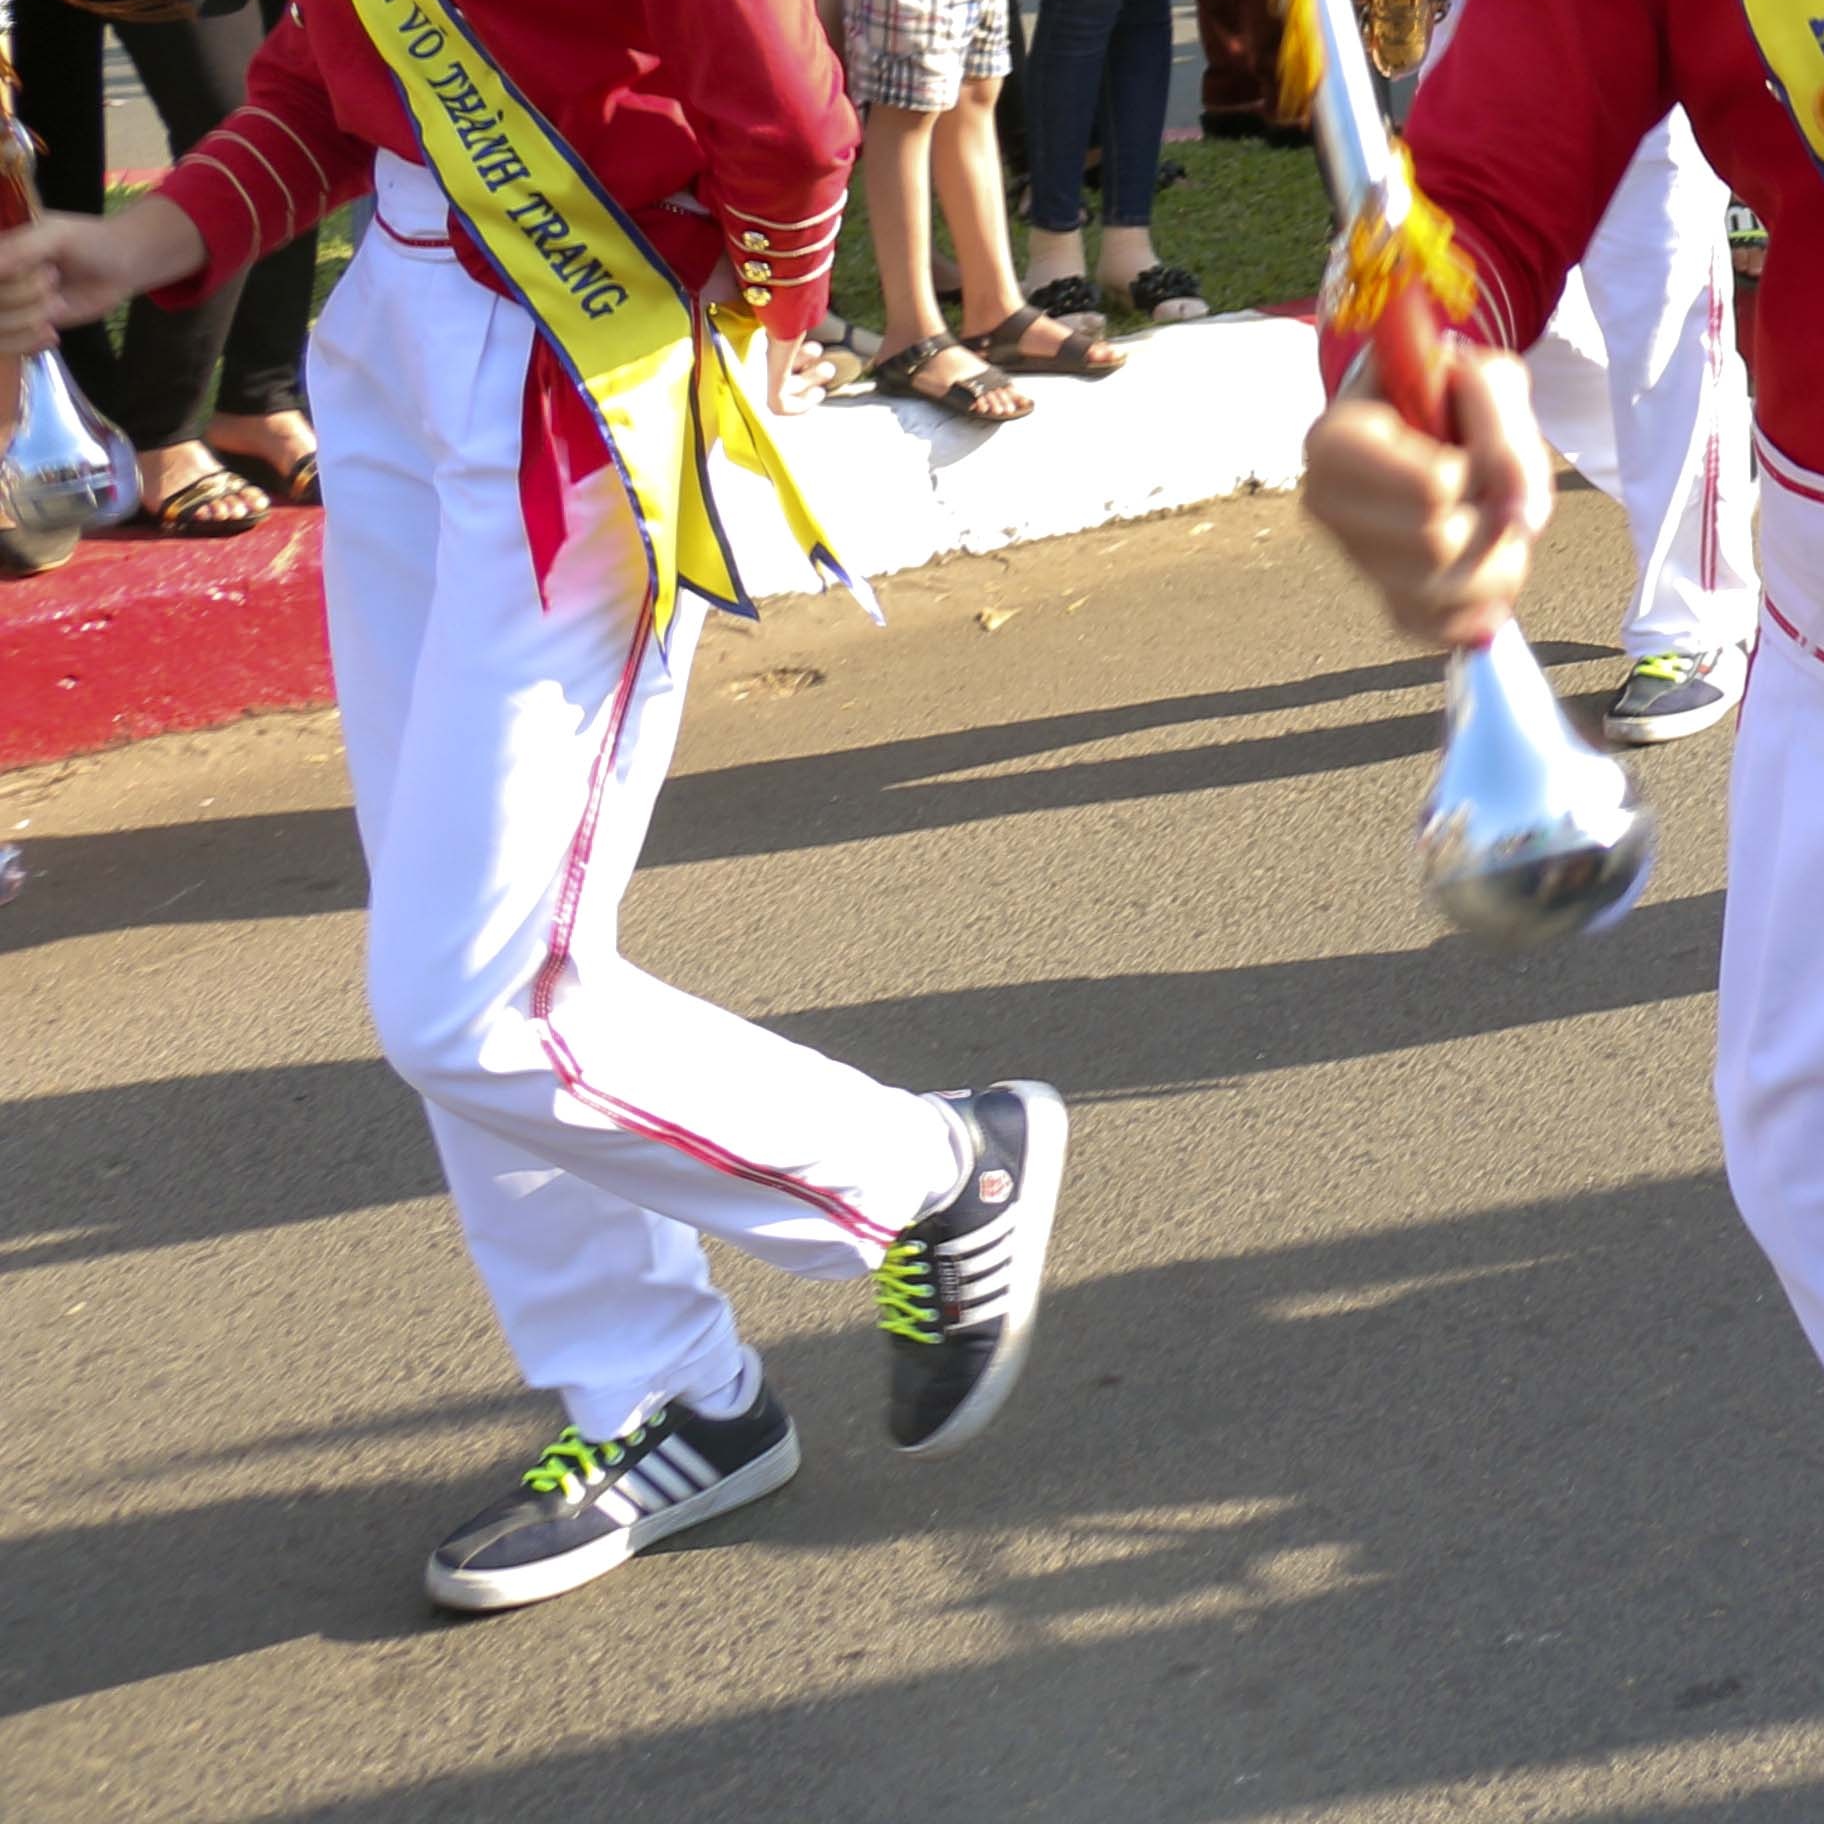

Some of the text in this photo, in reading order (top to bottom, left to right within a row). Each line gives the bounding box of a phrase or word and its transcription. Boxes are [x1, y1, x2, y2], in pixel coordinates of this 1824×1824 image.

[398, 0, 449, 60] VÕ
[426, 60, 532, 193] THÀNH
[506, 190, 630, 319] TRANG
